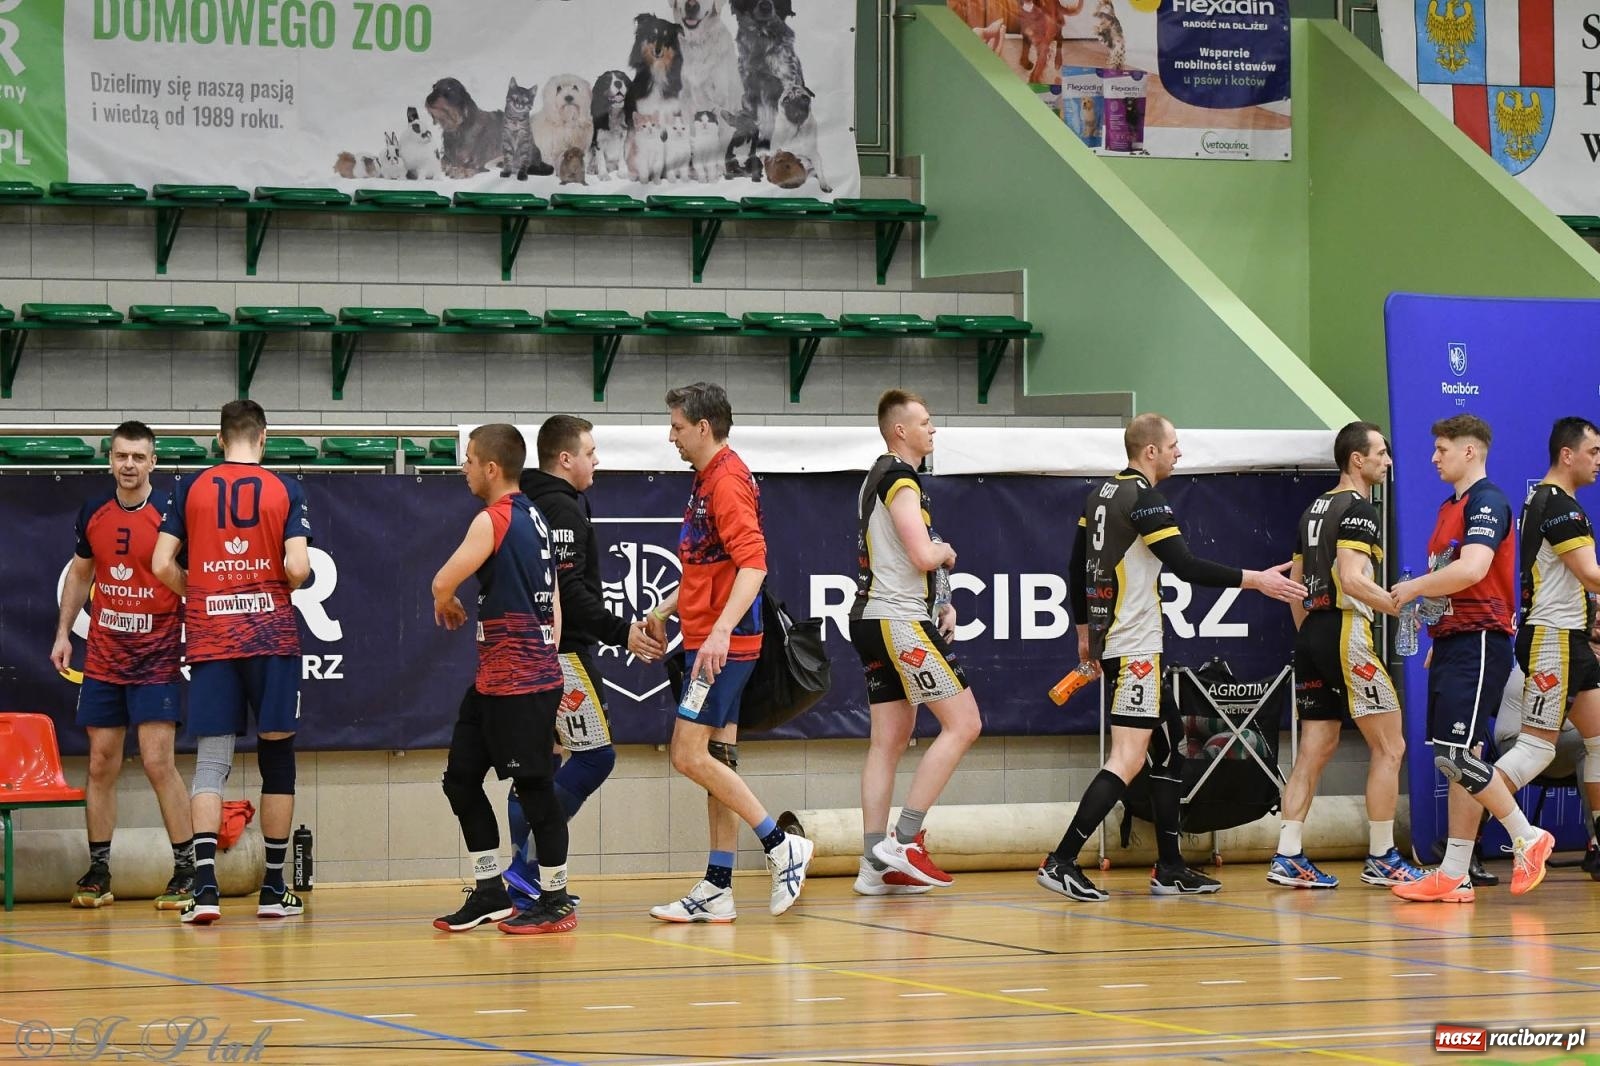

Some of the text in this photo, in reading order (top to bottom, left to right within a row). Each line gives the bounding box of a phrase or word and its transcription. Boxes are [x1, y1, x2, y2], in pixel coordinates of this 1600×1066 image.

[1172, 0, 1275, 15] Flexadin
[93, 0, 432, 53] DOMOWEGO ZOO
[1182, 20, 1217, 29] RADOŚĆ
[1199, 47, 1250, 60] Wsparcie
[1174, 60, 1276, 72] mobilności stawów
[91, 72, 294, 105] Dzielimy się naszą pasją
[1183, 74, 1266, 87] u psów i kotów
[92, 102, 284, 130] i wiedzą od 1989 roku.
[1441, 382, 1480, 395] Racibórz
[212, 476, 262, 529] 10
[551, 529, 575, 543] NTER
[1092, 505, 1107, 551] 3
[115, 528, 131, 555] 3
[203, 558, 271, 573] KATOLIK
[218, 573, 258, 581] GROUP
[98, 582, 154, 598] KATOLIK
[112, 598, 141, 607] ROUP
[208, 594, 271, 612] nowiny.pl
[810, 572, 1249, 641] RCIBRZ
[912, 670, 937, 690] 10
[1131, 685, 1144, 706] 3
[1364, 686, 1380, 705] 4
[1532, 696, 1545, 716] 11
[565, 715, 587, 738] 14
[295, 844, 303, 887] stadium
